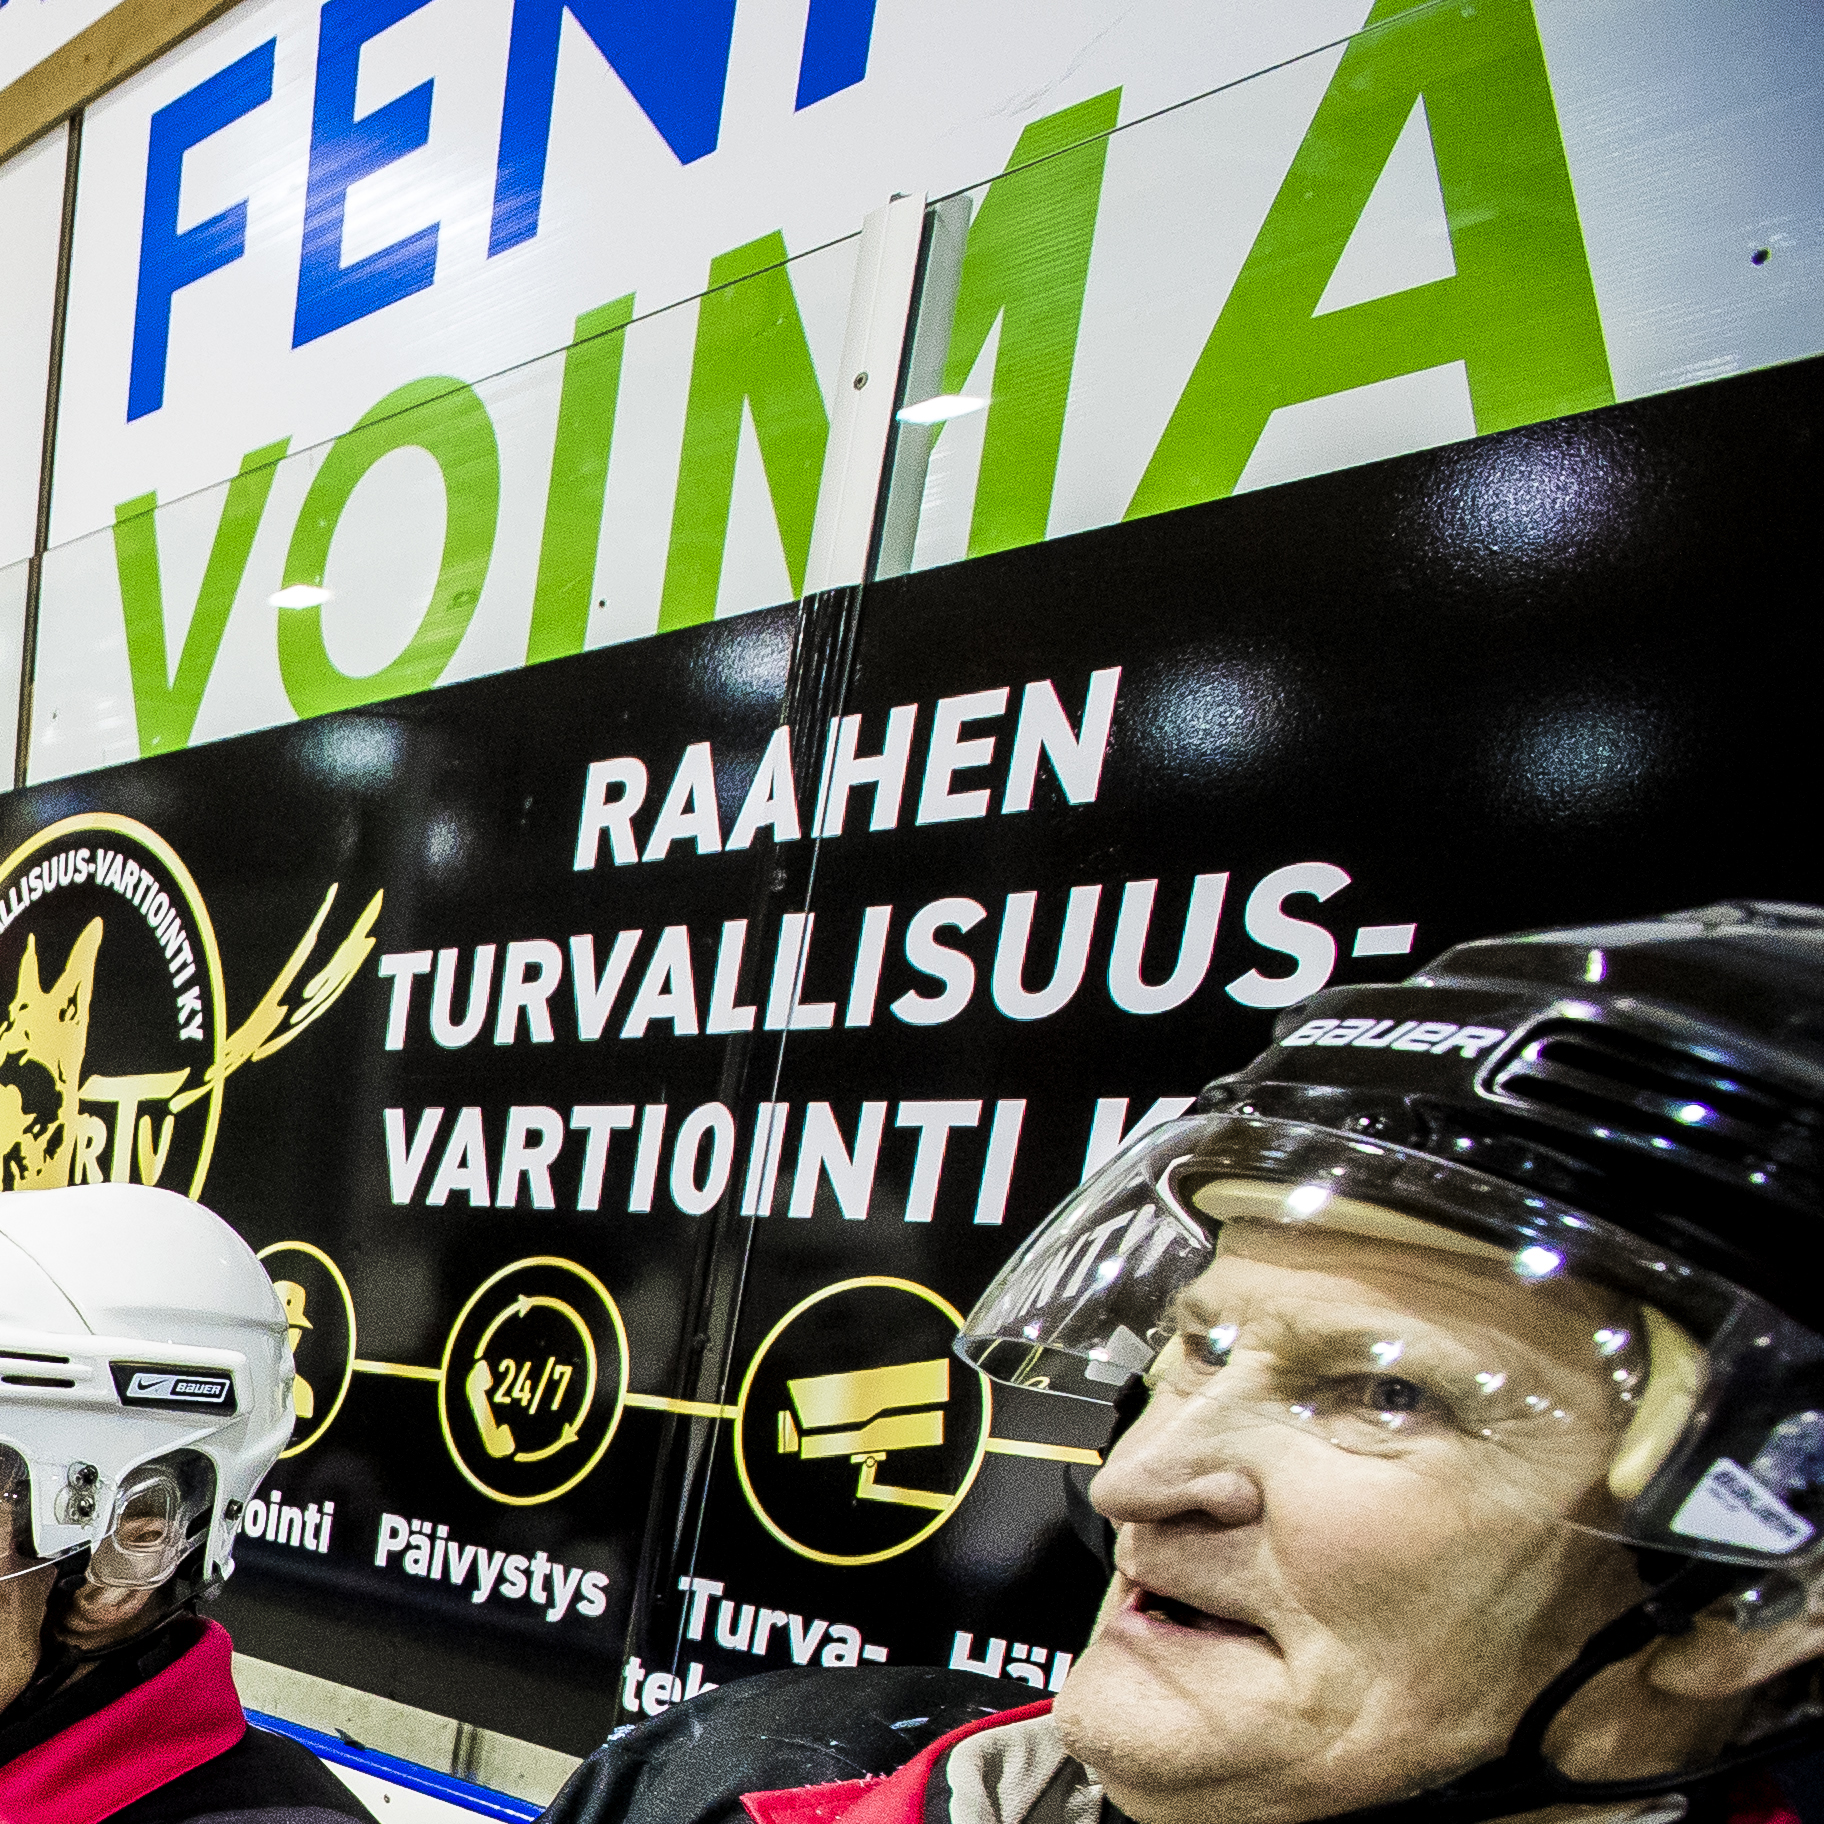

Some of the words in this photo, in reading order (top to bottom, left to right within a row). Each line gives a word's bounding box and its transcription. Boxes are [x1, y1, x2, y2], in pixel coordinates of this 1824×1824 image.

[114, 0, 1616, 758] VOIMA
[573, 666, 1122, 871] RAAHEN
[377, 862, 1417, 1051] TURVALLISUUS-
[177, 985, 204, 1041] KY
[1281, 1018, 1508, 1059] BAUER
[382, 1098, 1027, 1226] VARTIOINTI
[174, 1378, 223, 1398] BAUER
[494, 1356, 573, 1414] 24/7
[375, 1512, 609, 1623] Päivystys
[678, 1576, 888, 1669] Turva-
